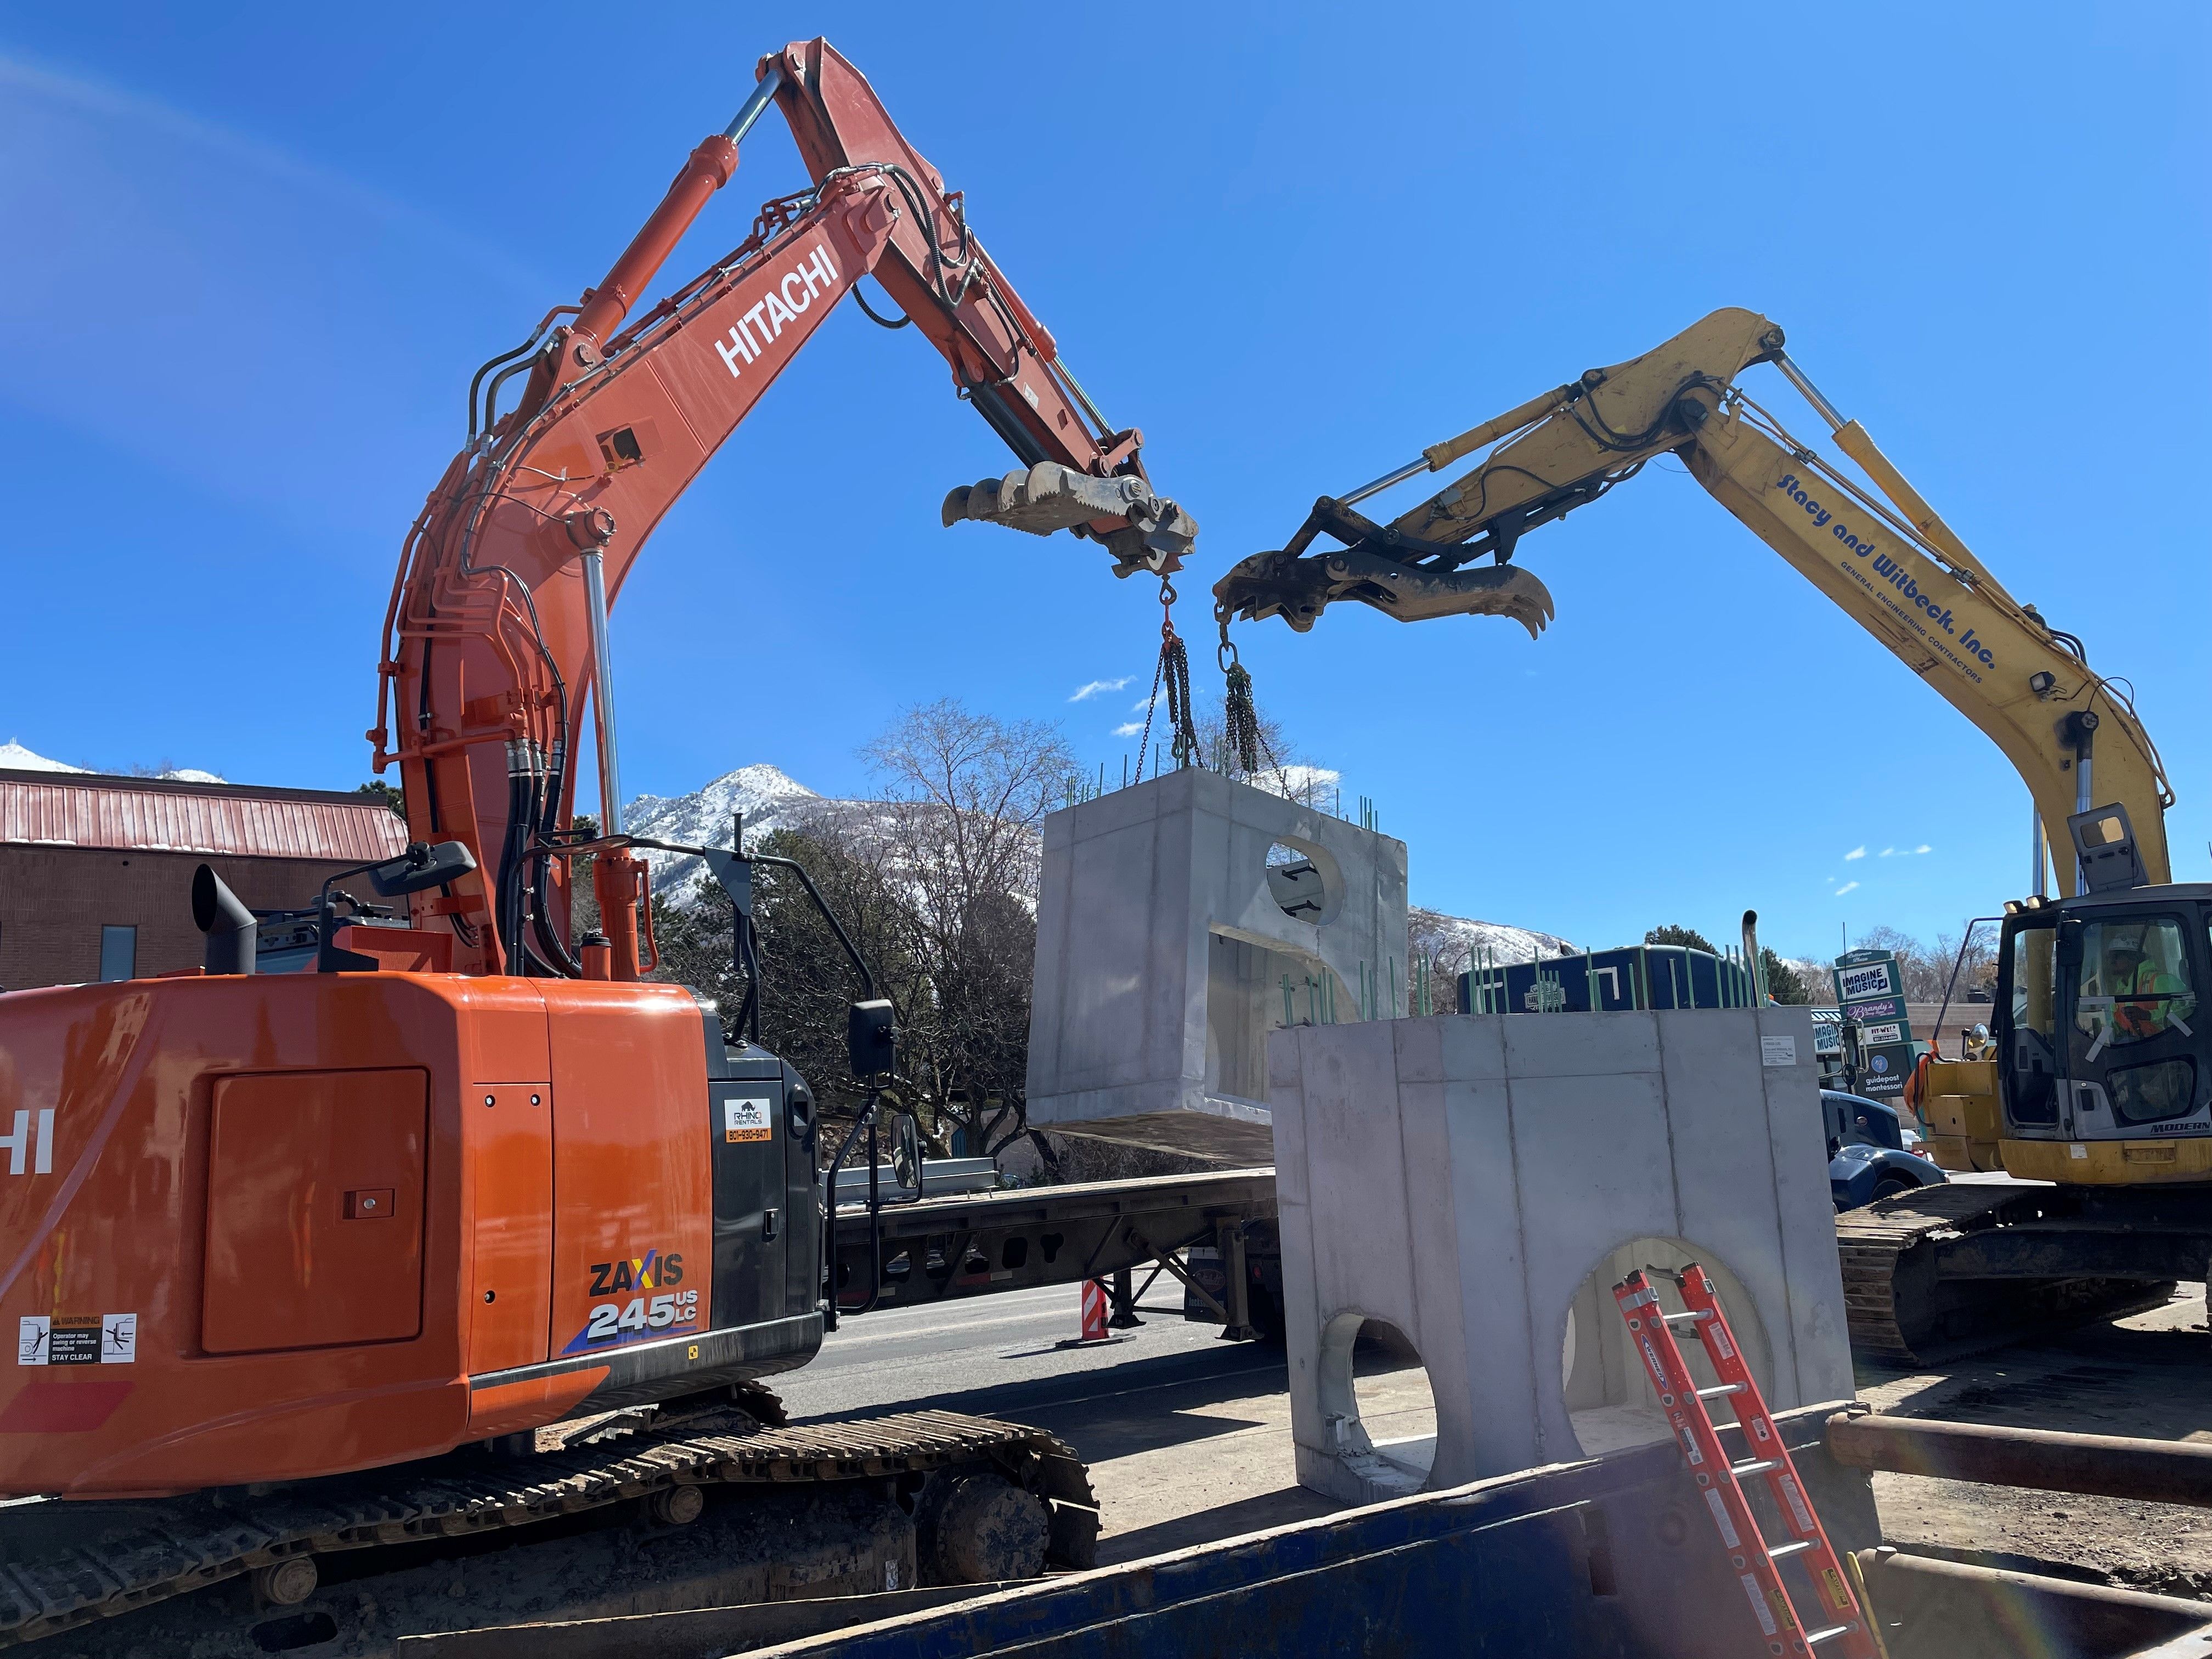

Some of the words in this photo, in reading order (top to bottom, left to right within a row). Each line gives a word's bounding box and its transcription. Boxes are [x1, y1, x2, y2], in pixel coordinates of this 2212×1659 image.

[714, 244, 838, 378] HITACHI
[1777, 474, 1832, 527] Stacy
[1833, 524, 1875, 557] and
[1872, 554, 1955, 635] Witbeck,
[1959, 629, 1995, 669] Inc.
[1841, 561, 1875, 592] GENERAL
[1876, 591, 1926, 636] ENGINEERING
[1928, 636, 1982, 684] CONTRACTORS
[1843, 968, 1882, 988] IMAGINE
[1847, 979, 1877, 995] MUSIC
[1847, 1001, 1893, 1019] Brandy's
[1817, 1035, 1839, 1051] MUSIC
[1866, 1074, 1899, 1086] guidepost
[1866, 1082, 1903, 1092] montessori
[734, 1111, 762, 1120] RHINO
[729, 1129, 768, 1140] 801-930-9471
[2151, 1122, 2210, 1133] MODERN
[589, 1249, 682, 1297] ZAXIS
[61, 1316, 100, 1325] WARNING
[587, 1294, 675, 1342] 245
[675, 1290, 698, 1306] US
[675, 1306, 697, 1323] LC
[1646, 1346, 1663, 1378] WERNER
